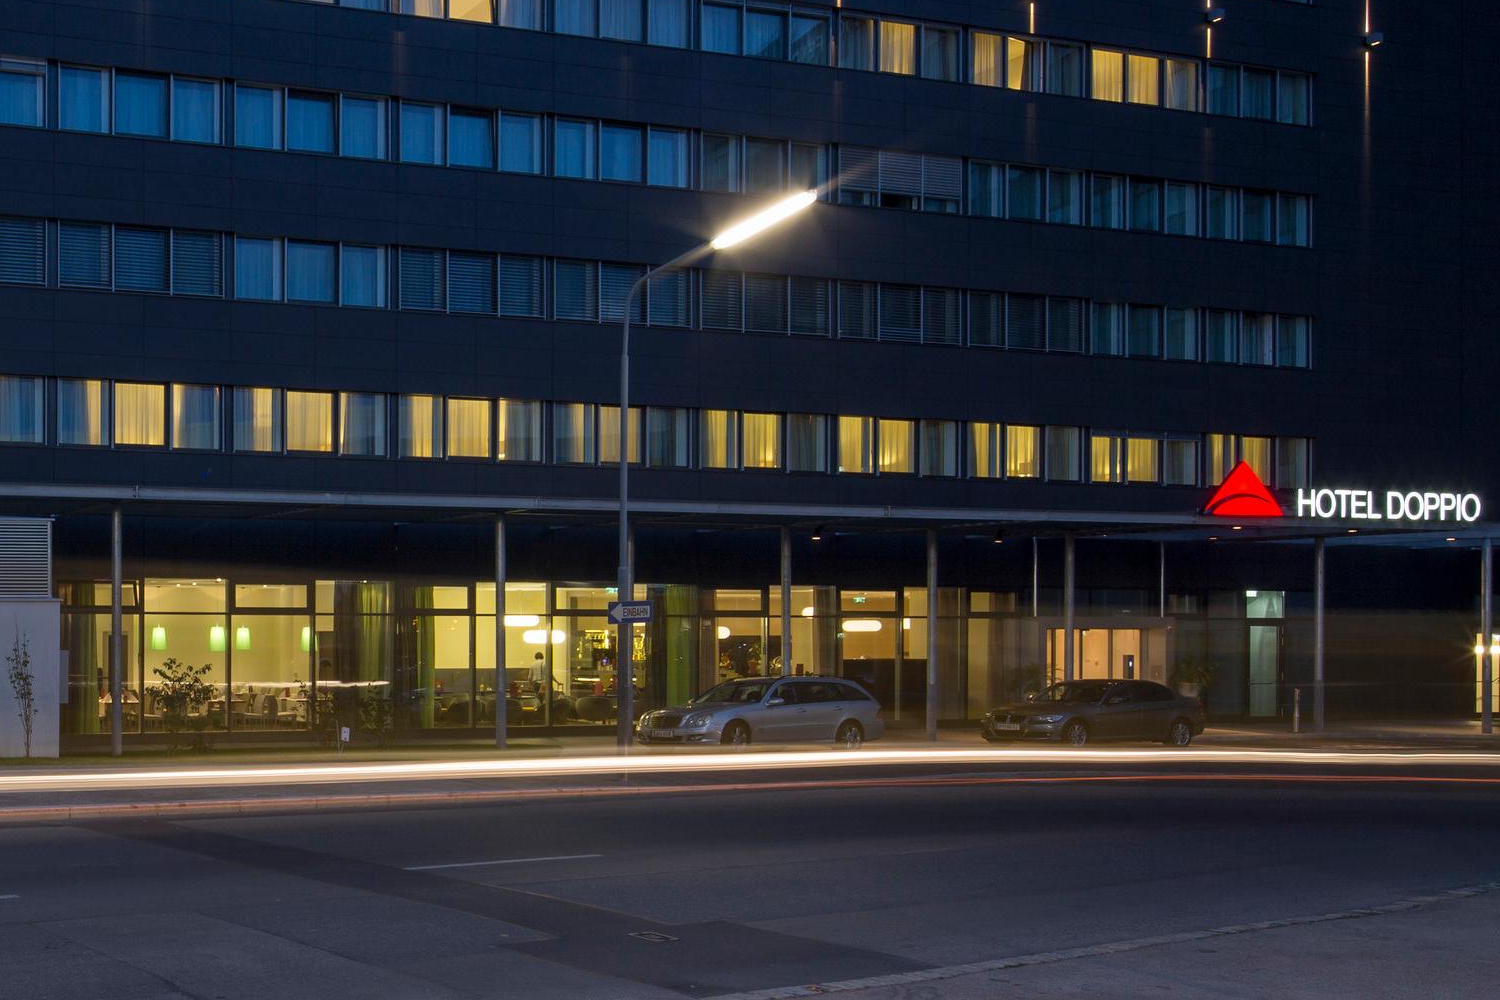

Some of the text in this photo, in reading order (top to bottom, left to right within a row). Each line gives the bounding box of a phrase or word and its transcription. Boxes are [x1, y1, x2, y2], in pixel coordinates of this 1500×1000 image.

[1298, 488, 1481, 522] HOTEL DOPPIO
[622, 607, 648, 617] EINBAHN
